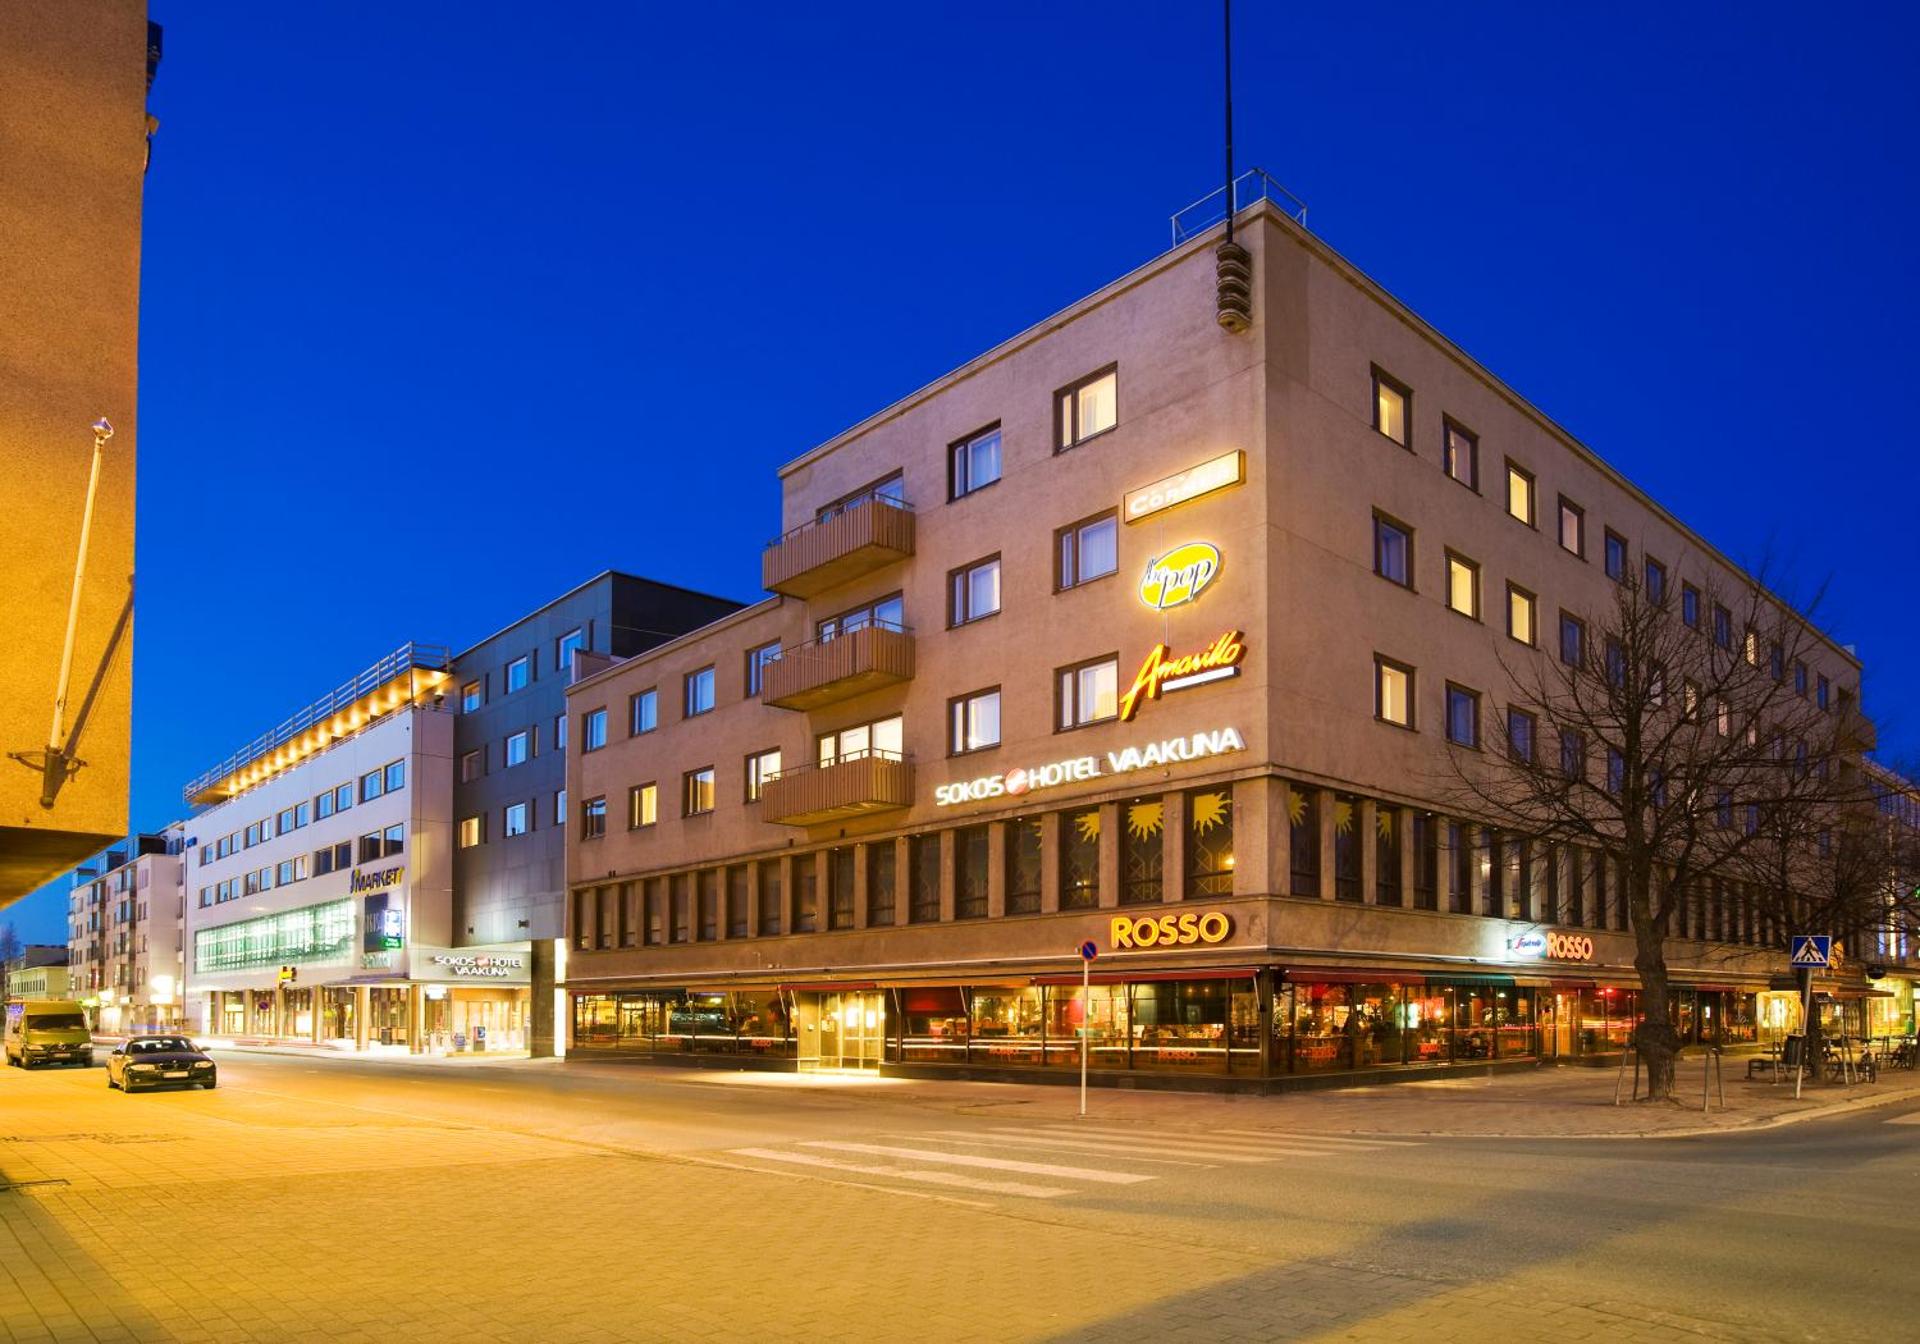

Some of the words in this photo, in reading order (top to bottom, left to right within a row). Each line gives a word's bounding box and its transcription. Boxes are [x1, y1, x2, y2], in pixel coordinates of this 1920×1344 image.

[1120, 631, 1242, 721] Amarillo
[936, 775, 1005, 806] SOKOS
[1028, 756, 1102, 789] HOTEL
[1108, 727, 1243, 773] VAAKUNA
[1110, 912, 1230, 948] ROSSO
[1546, 932, 1593, 960] ROSSO
[434, 955, 476, 966] SOKOS
[490, 957, 522, 968] HOTEL
[454, 966, 510, 976] VAAKUNA
